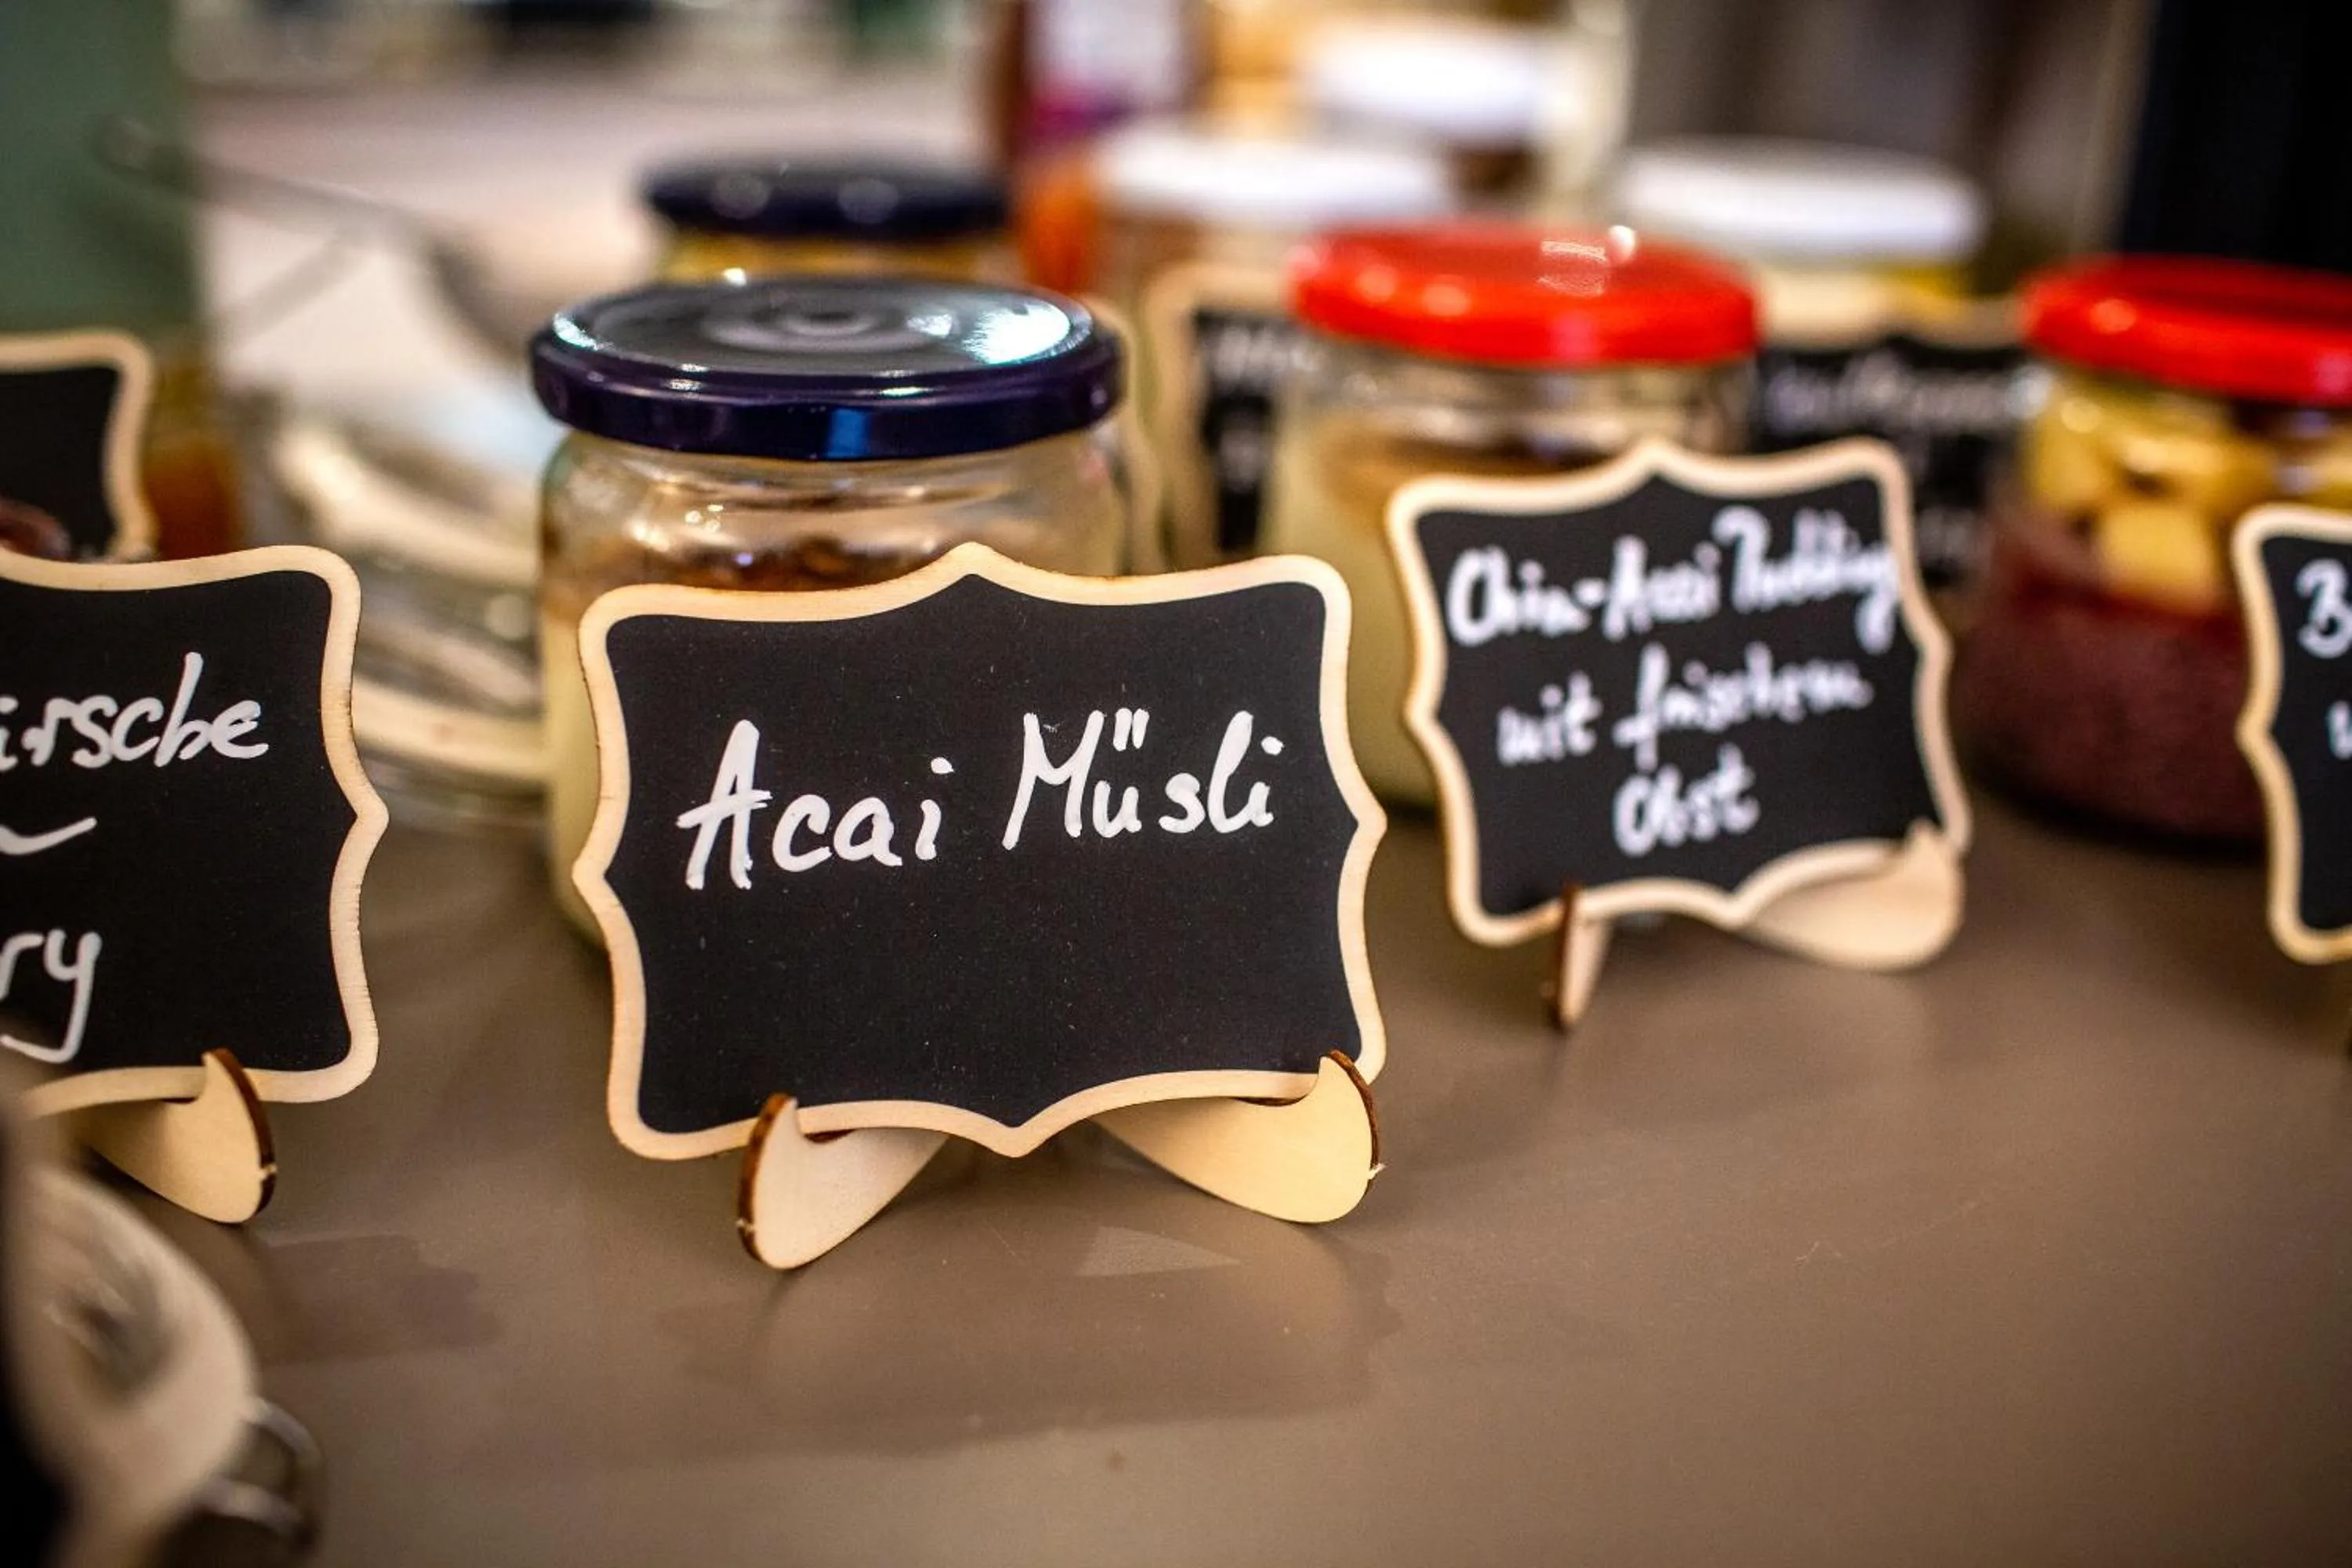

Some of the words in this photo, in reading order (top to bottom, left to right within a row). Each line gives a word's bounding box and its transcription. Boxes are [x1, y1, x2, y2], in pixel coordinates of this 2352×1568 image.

[1497, 672, 1602, 765] mit
[676, 719, 955, 890] Acai
[1001, 707, 1285, 851] Müsli
[1613, 743, 1759, 856] Obst
